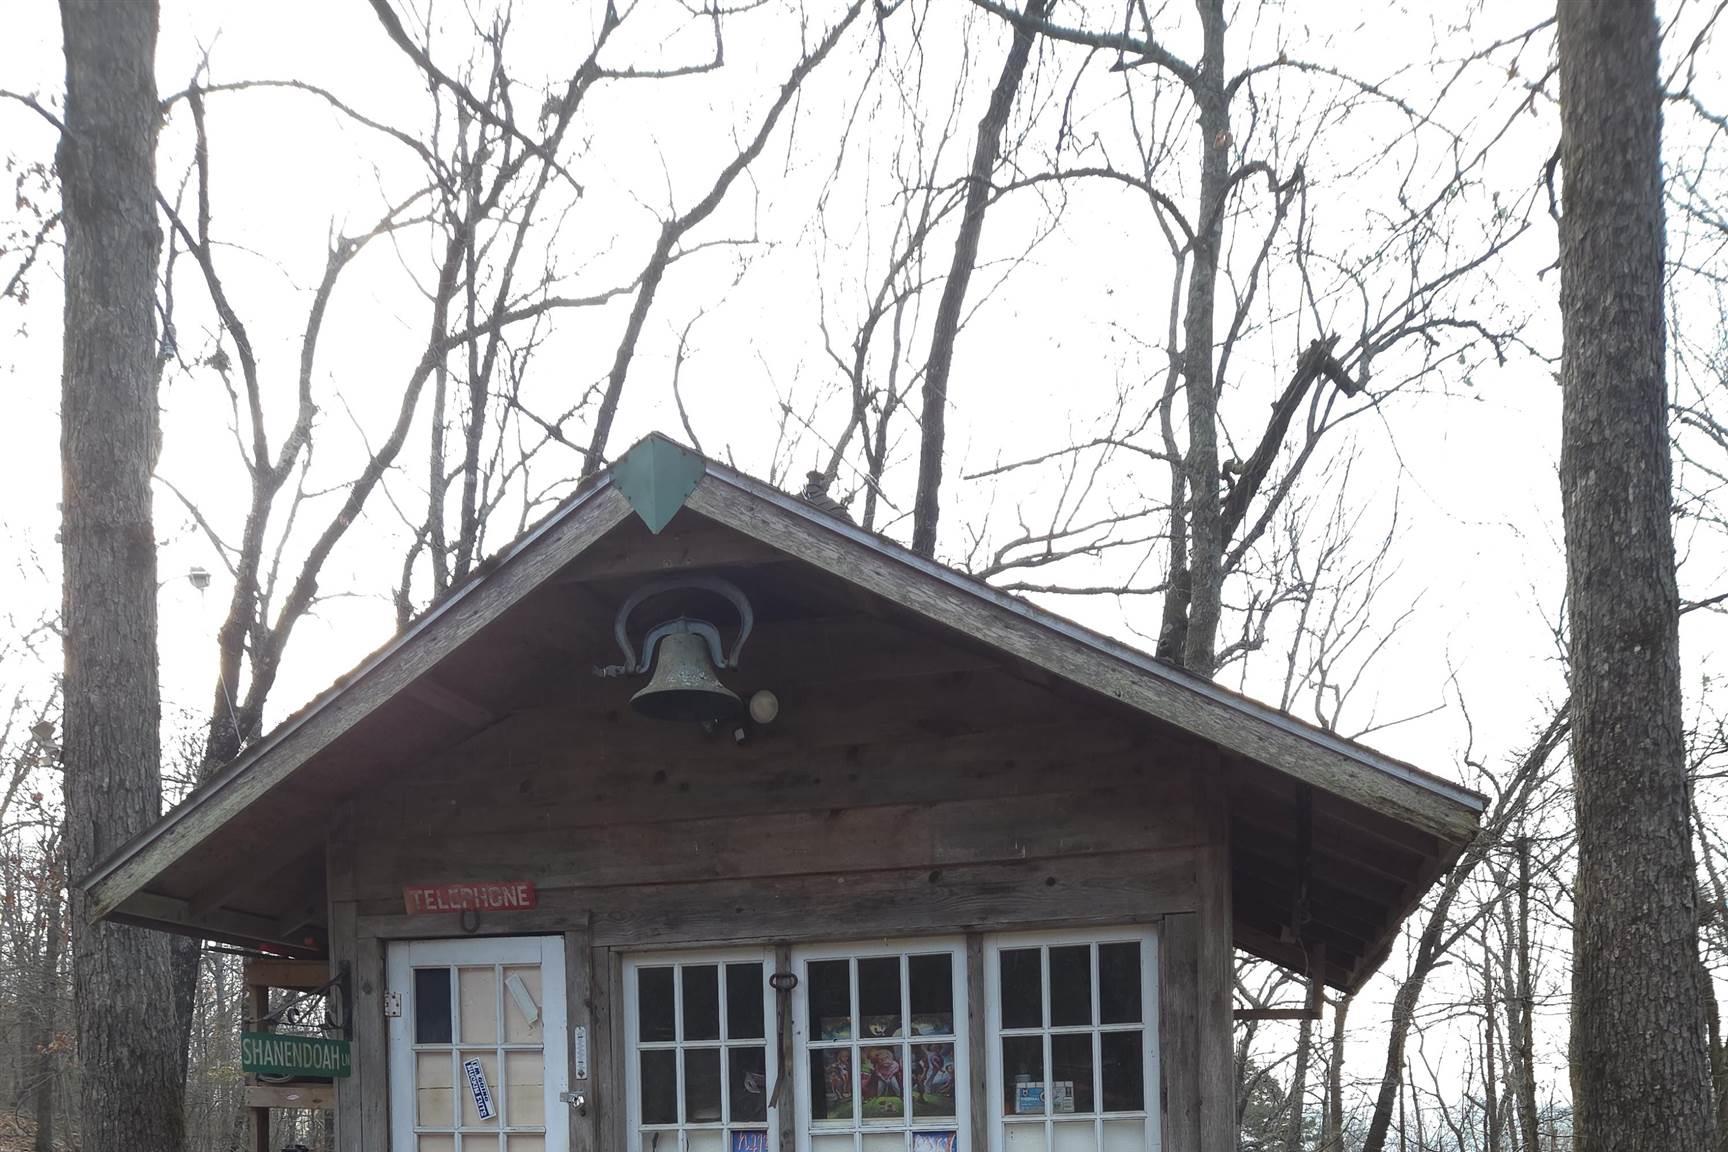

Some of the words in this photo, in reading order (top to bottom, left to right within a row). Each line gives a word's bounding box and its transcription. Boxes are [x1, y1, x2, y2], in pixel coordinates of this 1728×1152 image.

[411, 885, 530, 910] TELEPHONE
[242, 1038, 340, 1070] SHANENDOAH
[478, 1077, 489, 1101] GOING
